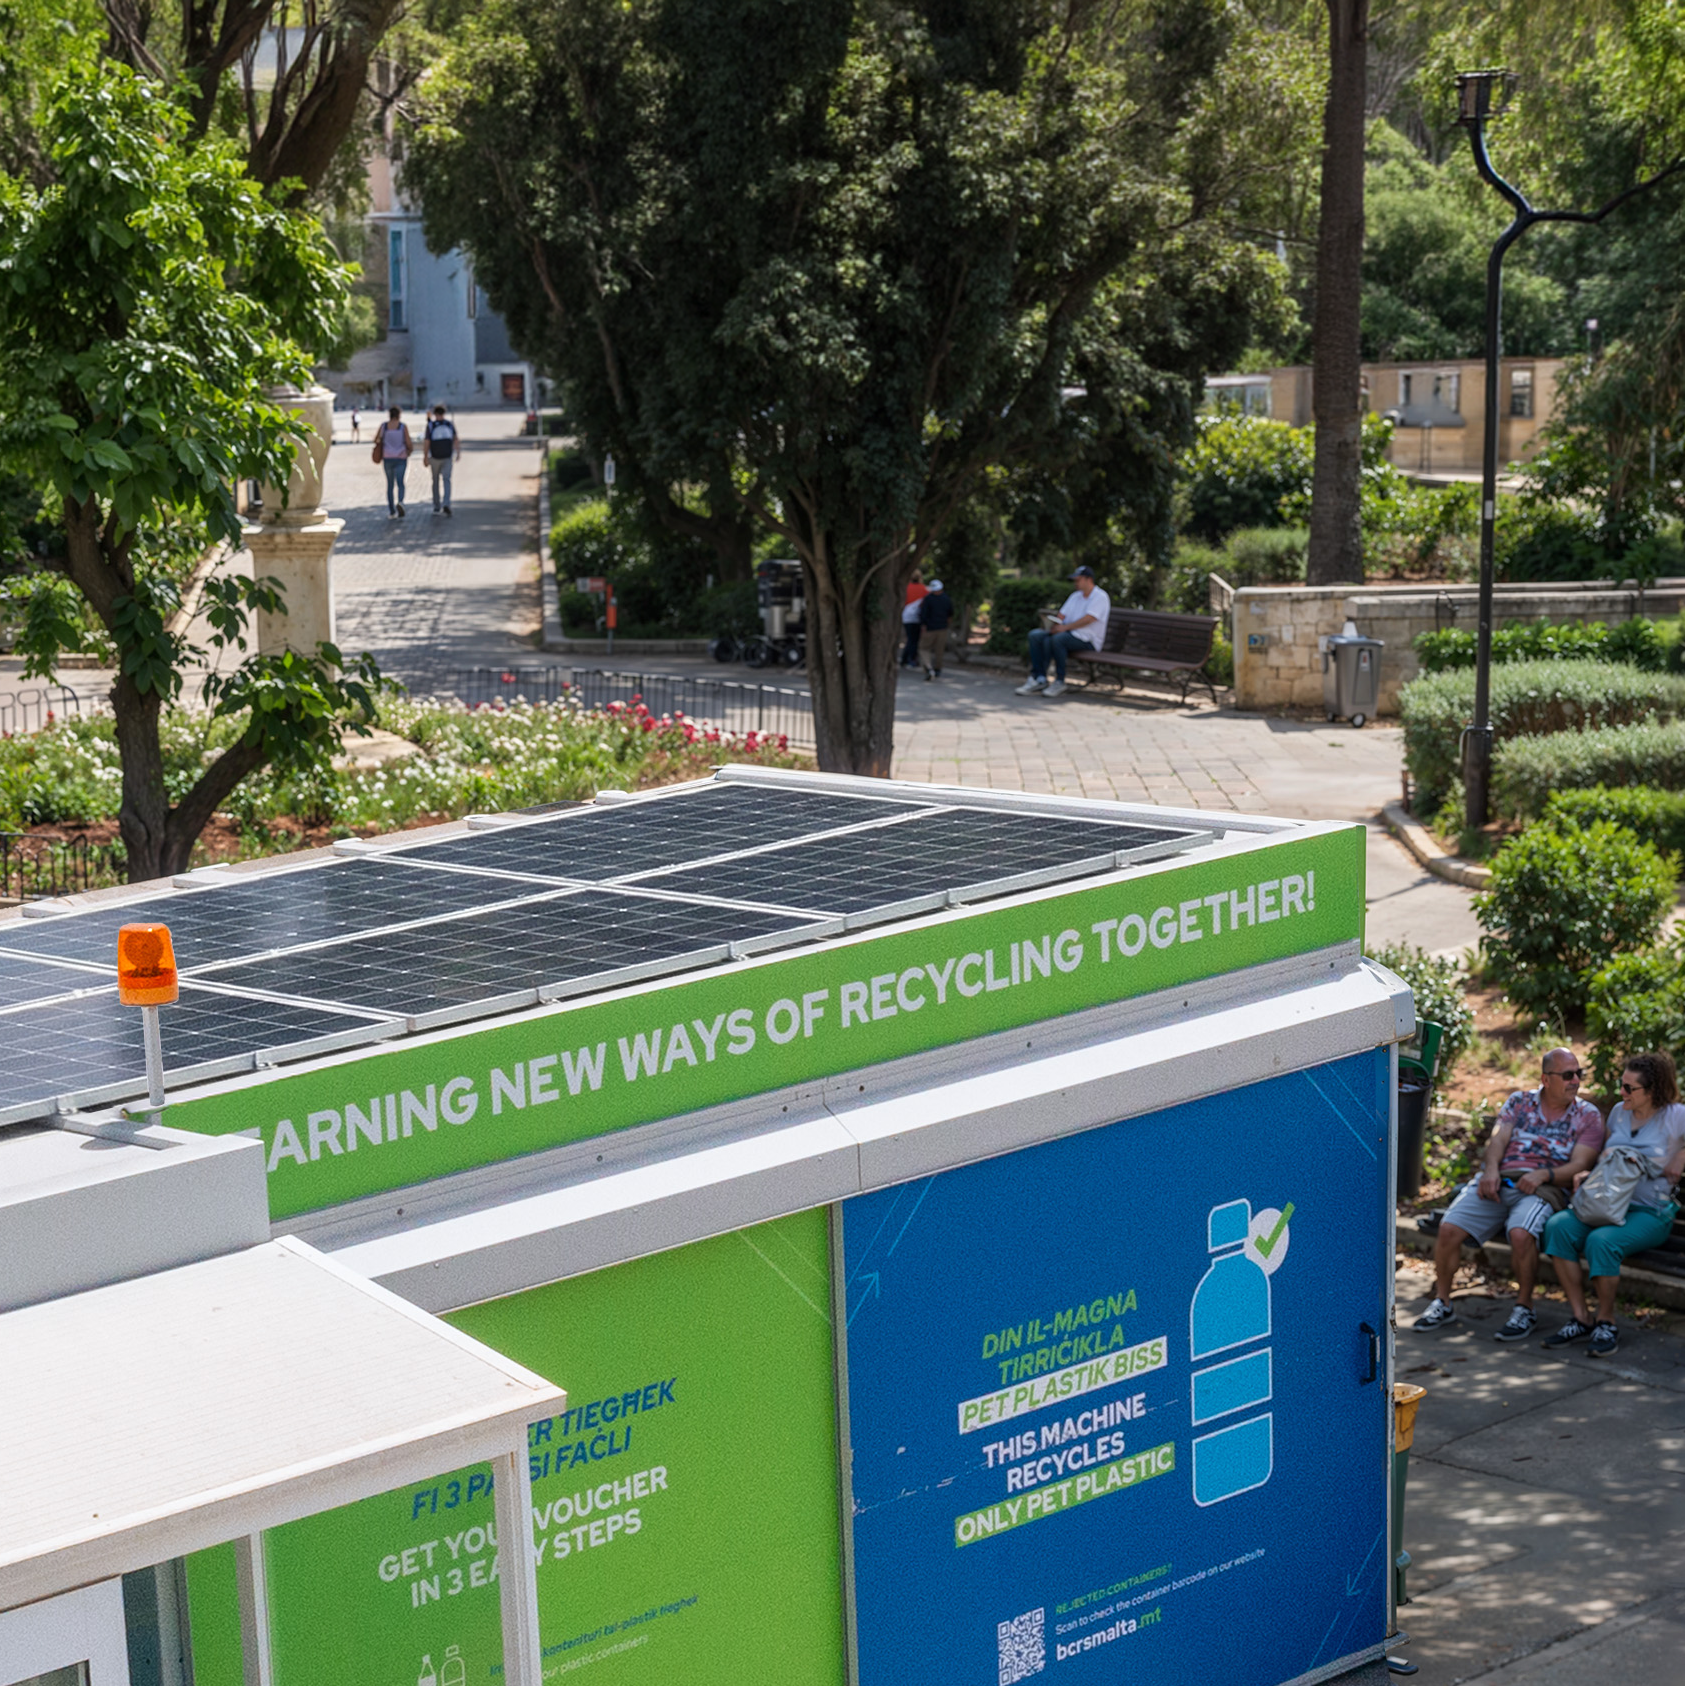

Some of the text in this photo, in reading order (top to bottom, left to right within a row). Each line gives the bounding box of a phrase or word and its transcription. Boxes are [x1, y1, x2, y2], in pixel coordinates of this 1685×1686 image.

[151, 870, 1316, 1173] ARNING NEW WAYS OF RECYCLING TOGETHER!
[982, 1288, 1138, 1360] DIN IL-MAGNA
[962, 1341, 1164, 1430] PET PLASTIK BISS
[982, 1392, 1146, 1468] THIS MACHINE
[1006, 1431, 1126, 1493] RECYCLES
[378, 1465, 668, 1582] GET YOU VOUCHER
[412, 1487, 439, 1520] FI
[444, 1481, 461, 1509] 3
[957, 1446, 1172, 1542] ONLY PET PLASTIC
[411, 1574, 441, 1608] IN
[447, 1569, 464, 1596] 3
[553, 1508, 642, 1559] STEPS
[1055, 1548, 1265, 1636] Scan to check the container barcode on our website
[1056, 1606, 1162, 1661] bcrsmalta.mt
